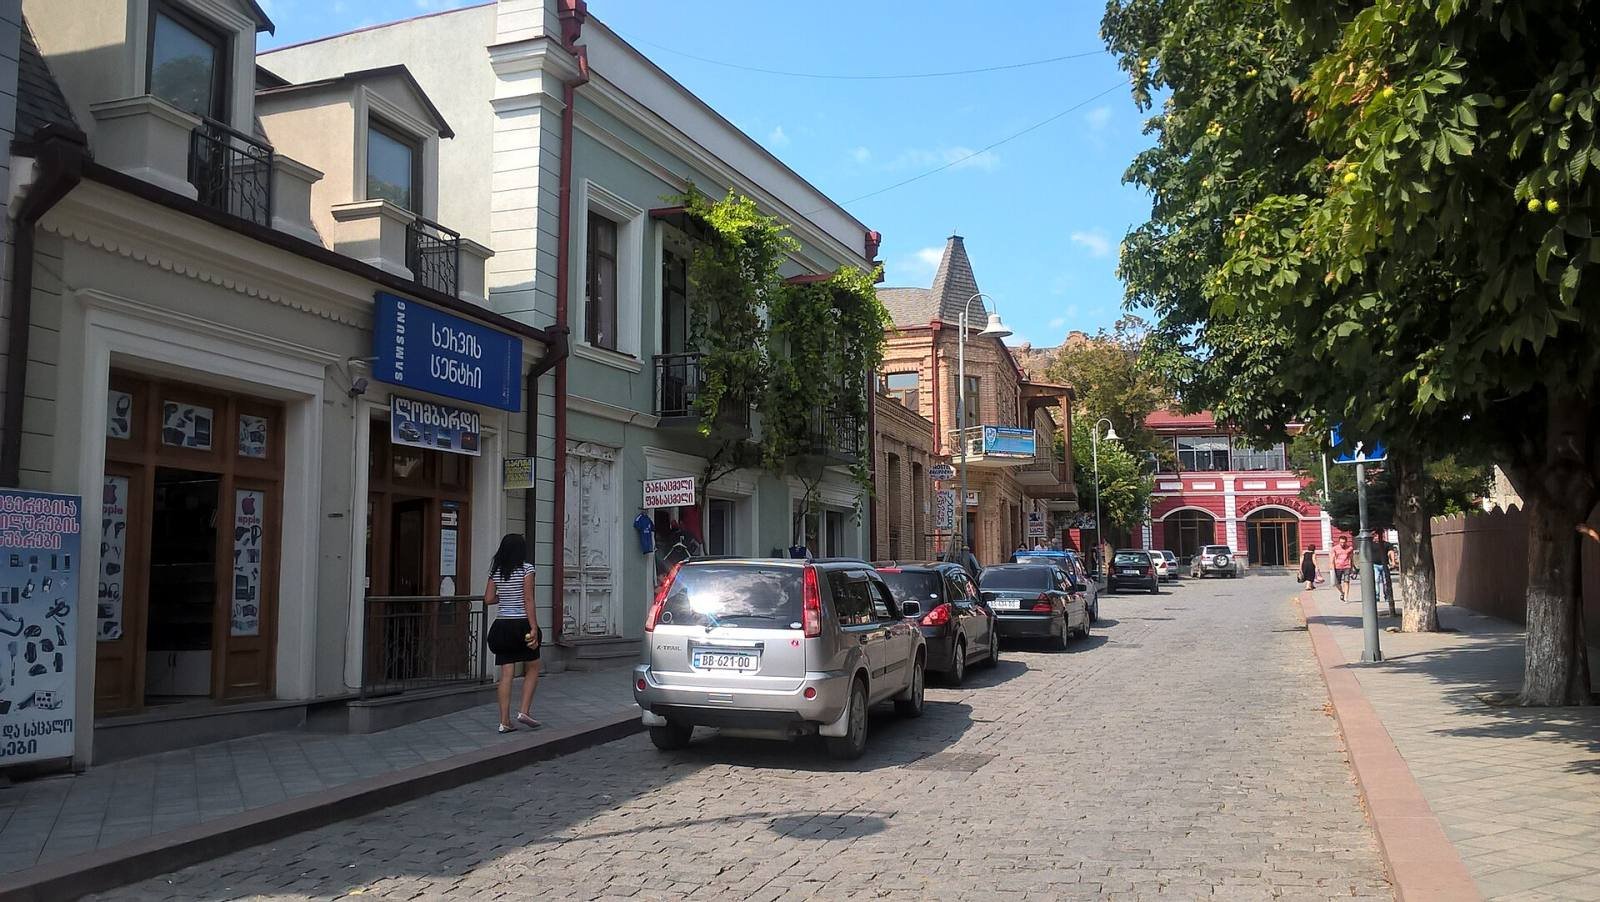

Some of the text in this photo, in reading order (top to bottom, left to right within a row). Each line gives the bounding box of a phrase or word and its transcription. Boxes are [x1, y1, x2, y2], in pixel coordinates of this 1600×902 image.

[394, 301, 406, 381] SAMSUNG
[432, 322, 482, 360] სერვის
[430, 354, 482, 390] ცენტრი
[395, 398, 479, 434] ლომბარდი
[645, 479, 693, 493] განსაცმელი
[645, 493, 693, 507] ფეხსაცმელი
[237, 514, 261, 526] apple
[702, 655, 750, 668] BB-621-00
[2, 718, 73, 740] და საცალო
